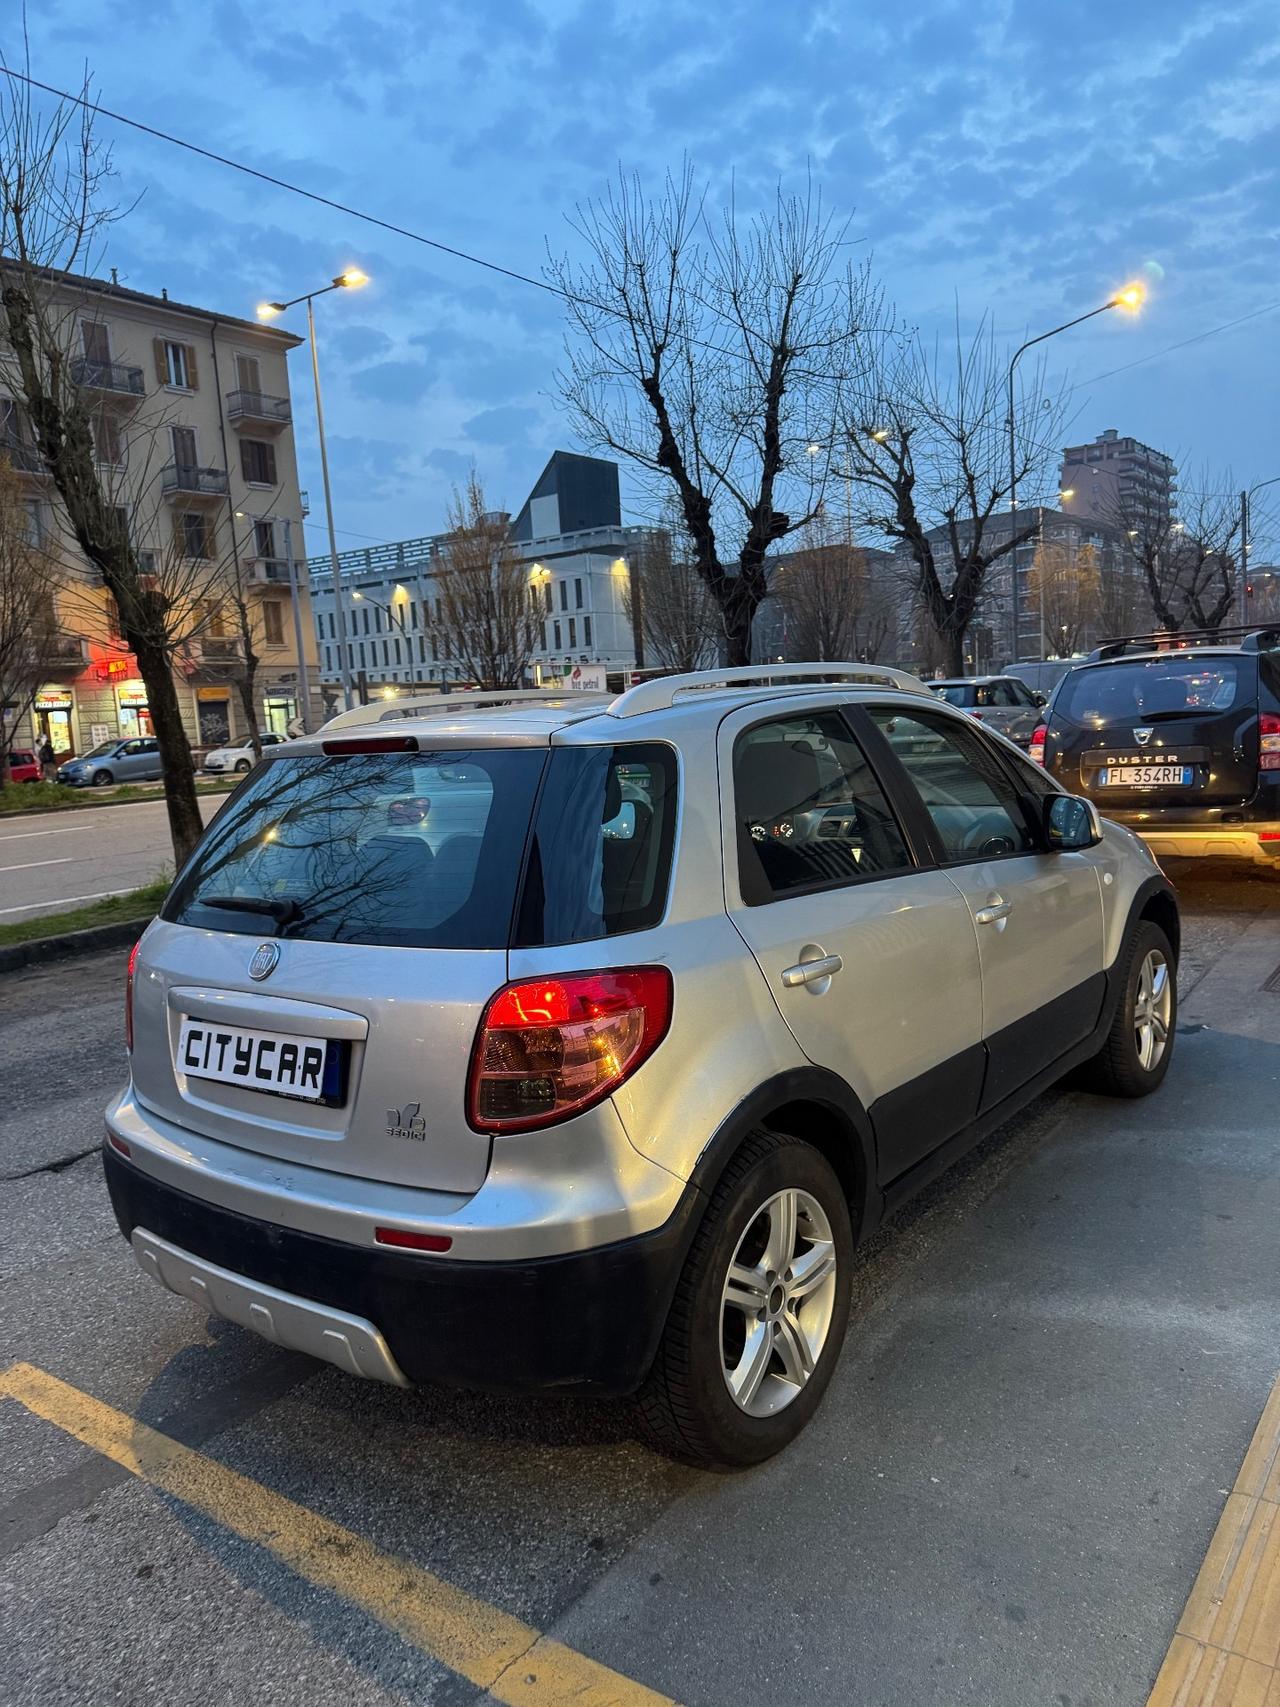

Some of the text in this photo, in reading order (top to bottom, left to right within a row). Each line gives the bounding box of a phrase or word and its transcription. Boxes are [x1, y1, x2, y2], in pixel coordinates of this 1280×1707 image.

[1107, 755, 1178, 764] DUSTER
[1110, 768, 1182, 783] FL 354RH
[252, 951, 272, 969] FIAT
[184, 1029, 323, 1090] CITYCAR
[384, 1126, 426, 1142] SEDICI
